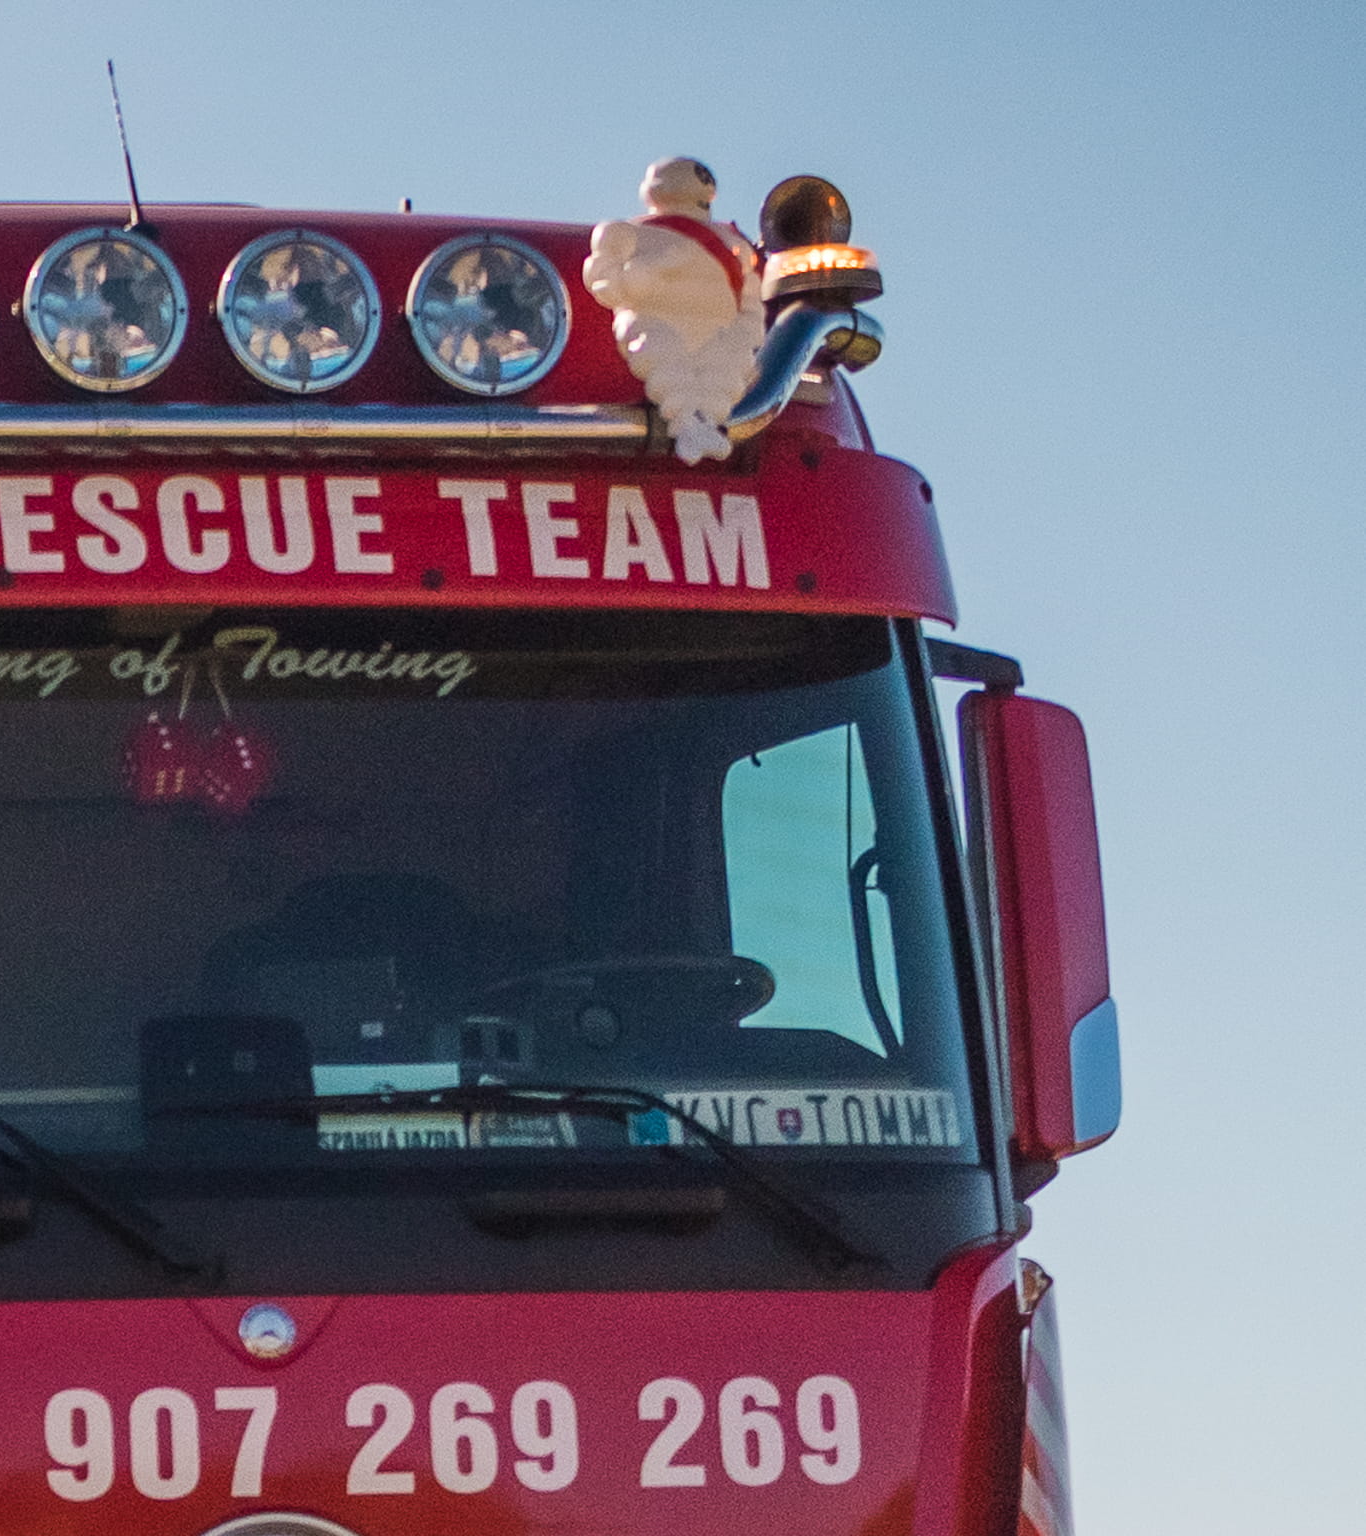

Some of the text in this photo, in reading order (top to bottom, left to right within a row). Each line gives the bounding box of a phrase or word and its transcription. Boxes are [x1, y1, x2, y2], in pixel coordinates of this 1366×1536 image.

[438, 479, 773, 590] TEAM
[110, 633, 180, 695] of
[213, 626, 478, 697] Towing
[44, 1386, 279, 1501] 907
[345, 1381, 580, 1495] 269
[638, 1374, 863, 1488] 269
